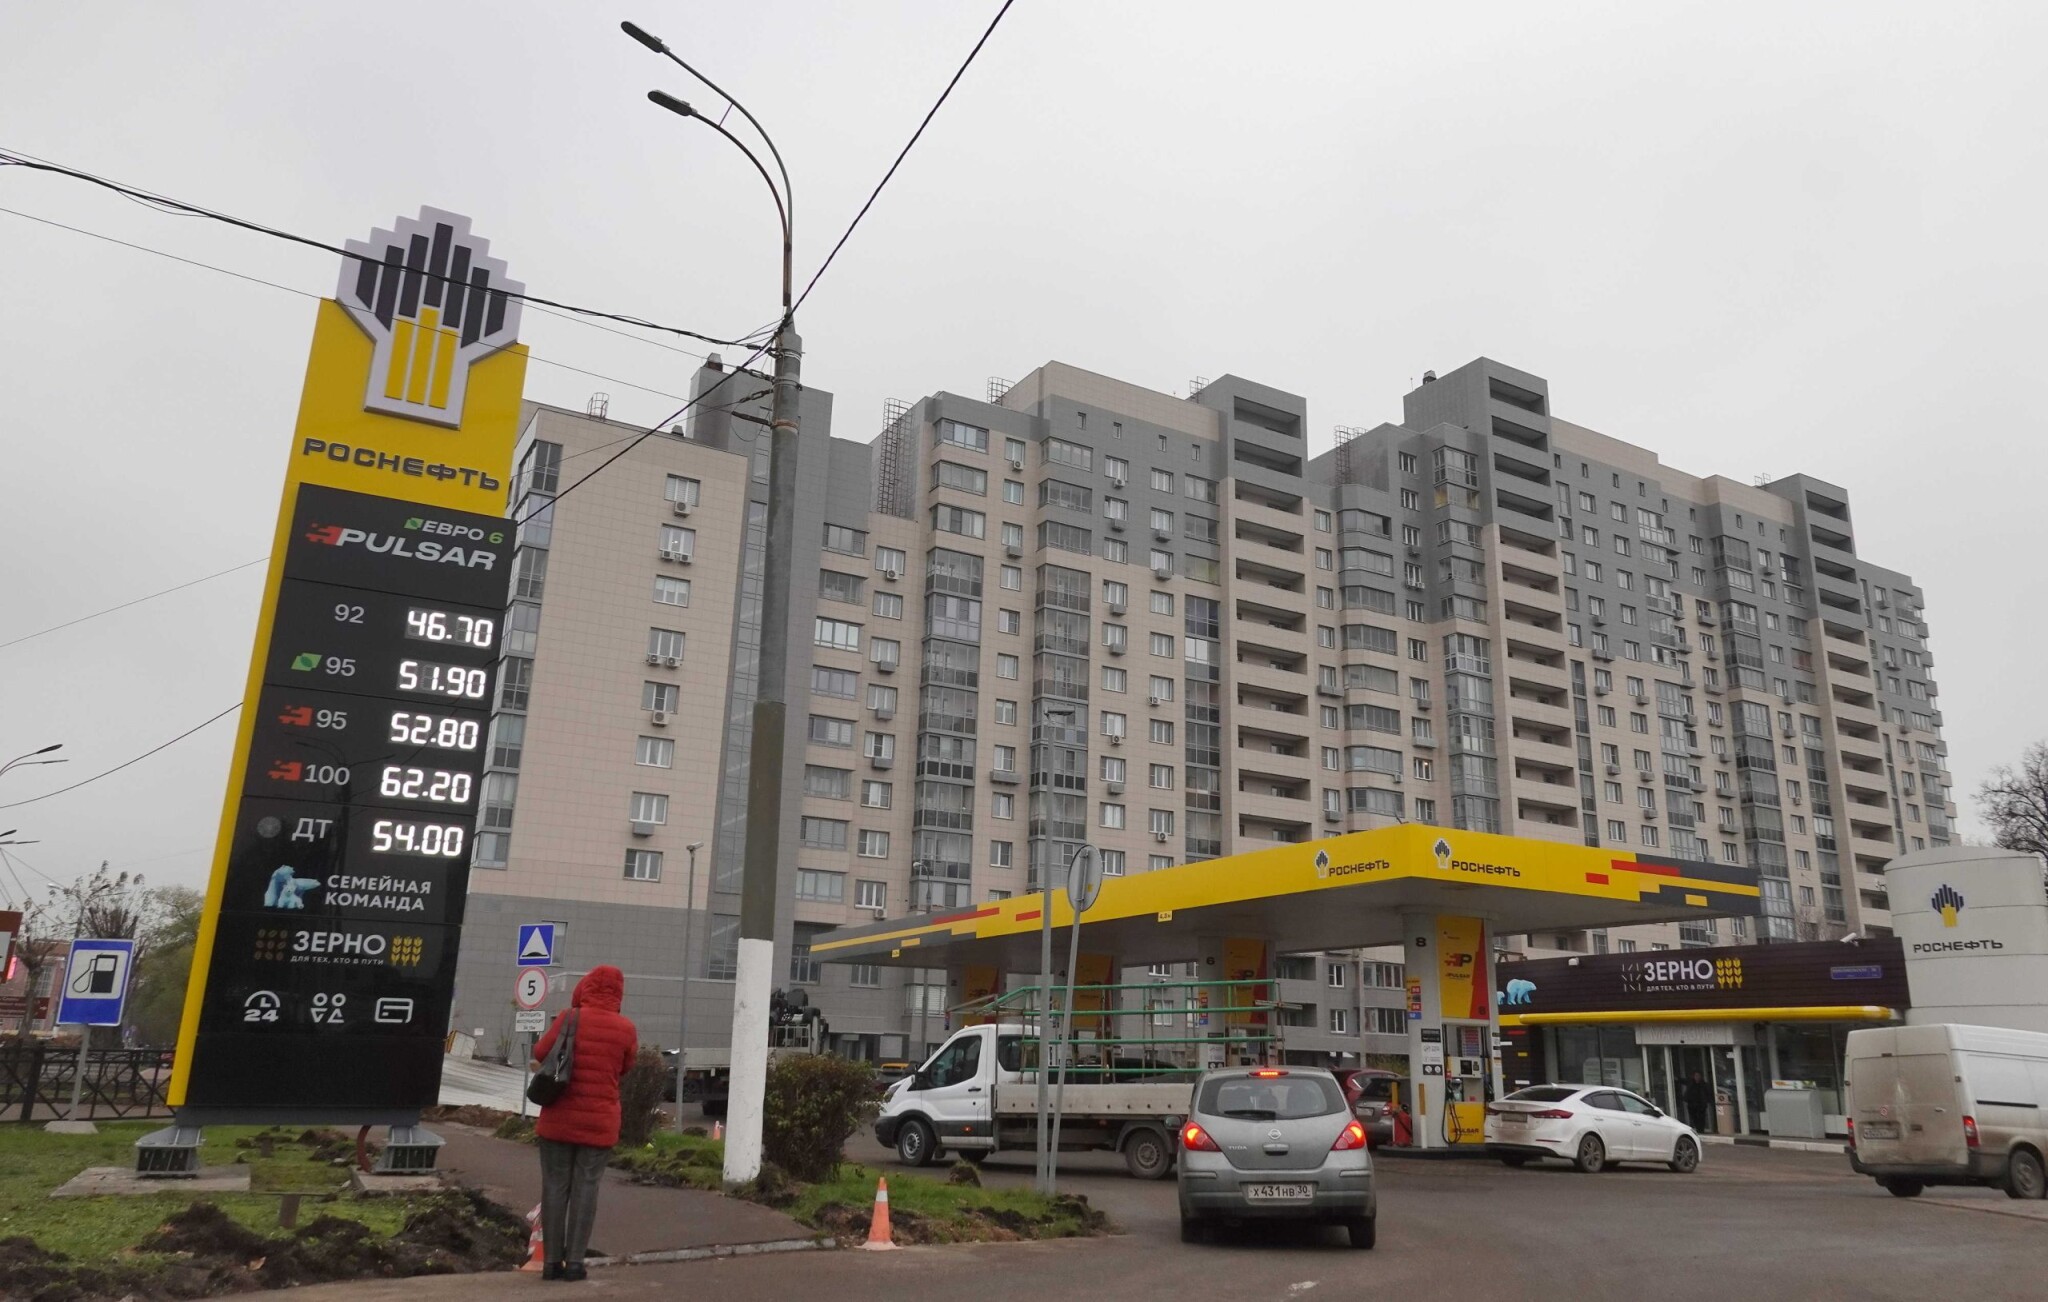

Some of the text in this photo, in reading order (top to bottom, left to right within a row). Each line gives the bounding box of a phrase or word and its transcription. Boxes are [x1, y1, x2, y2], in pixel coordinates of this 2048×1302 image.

[303, 438, 499, 491] РОСНЕФТЬ
[422, 520, 504, 544] ЕВРО 6
[336, 528, 497, 570] PULSAR
[334, 604, 493, 647] 92 46.70
[326, 656, 486, 698] 95 51.90
[316, 709, 479, 750] 95 52.80
[304, 764, 472, 803] 100 62.20
[291, 817, 464, 857] ДТ 54.00
[1328, 859, 1390, 877] РОСНЕФТЬ
[1451, 860, 1521, 878] РОСНЕФТЬ
[327, 874, 432, 895] СЕМЕЙНАЯ
[324, 892, 425, 912] КОМАНДА
[292, 930, 386, 955] ЗЕРНО
[1415, 937, 1426, 947] 8
[1913, 939, 2003, 953] РОСНЕФТЬ
[290, 955, 310, 963] ДЛЯ
[1206, 957, 1215, 965] 6
[1644, 959, 1714, 982] ЗЕРНО
[527, 979, 536, 996] 5
[244, 1009, 280, 1022] 24
